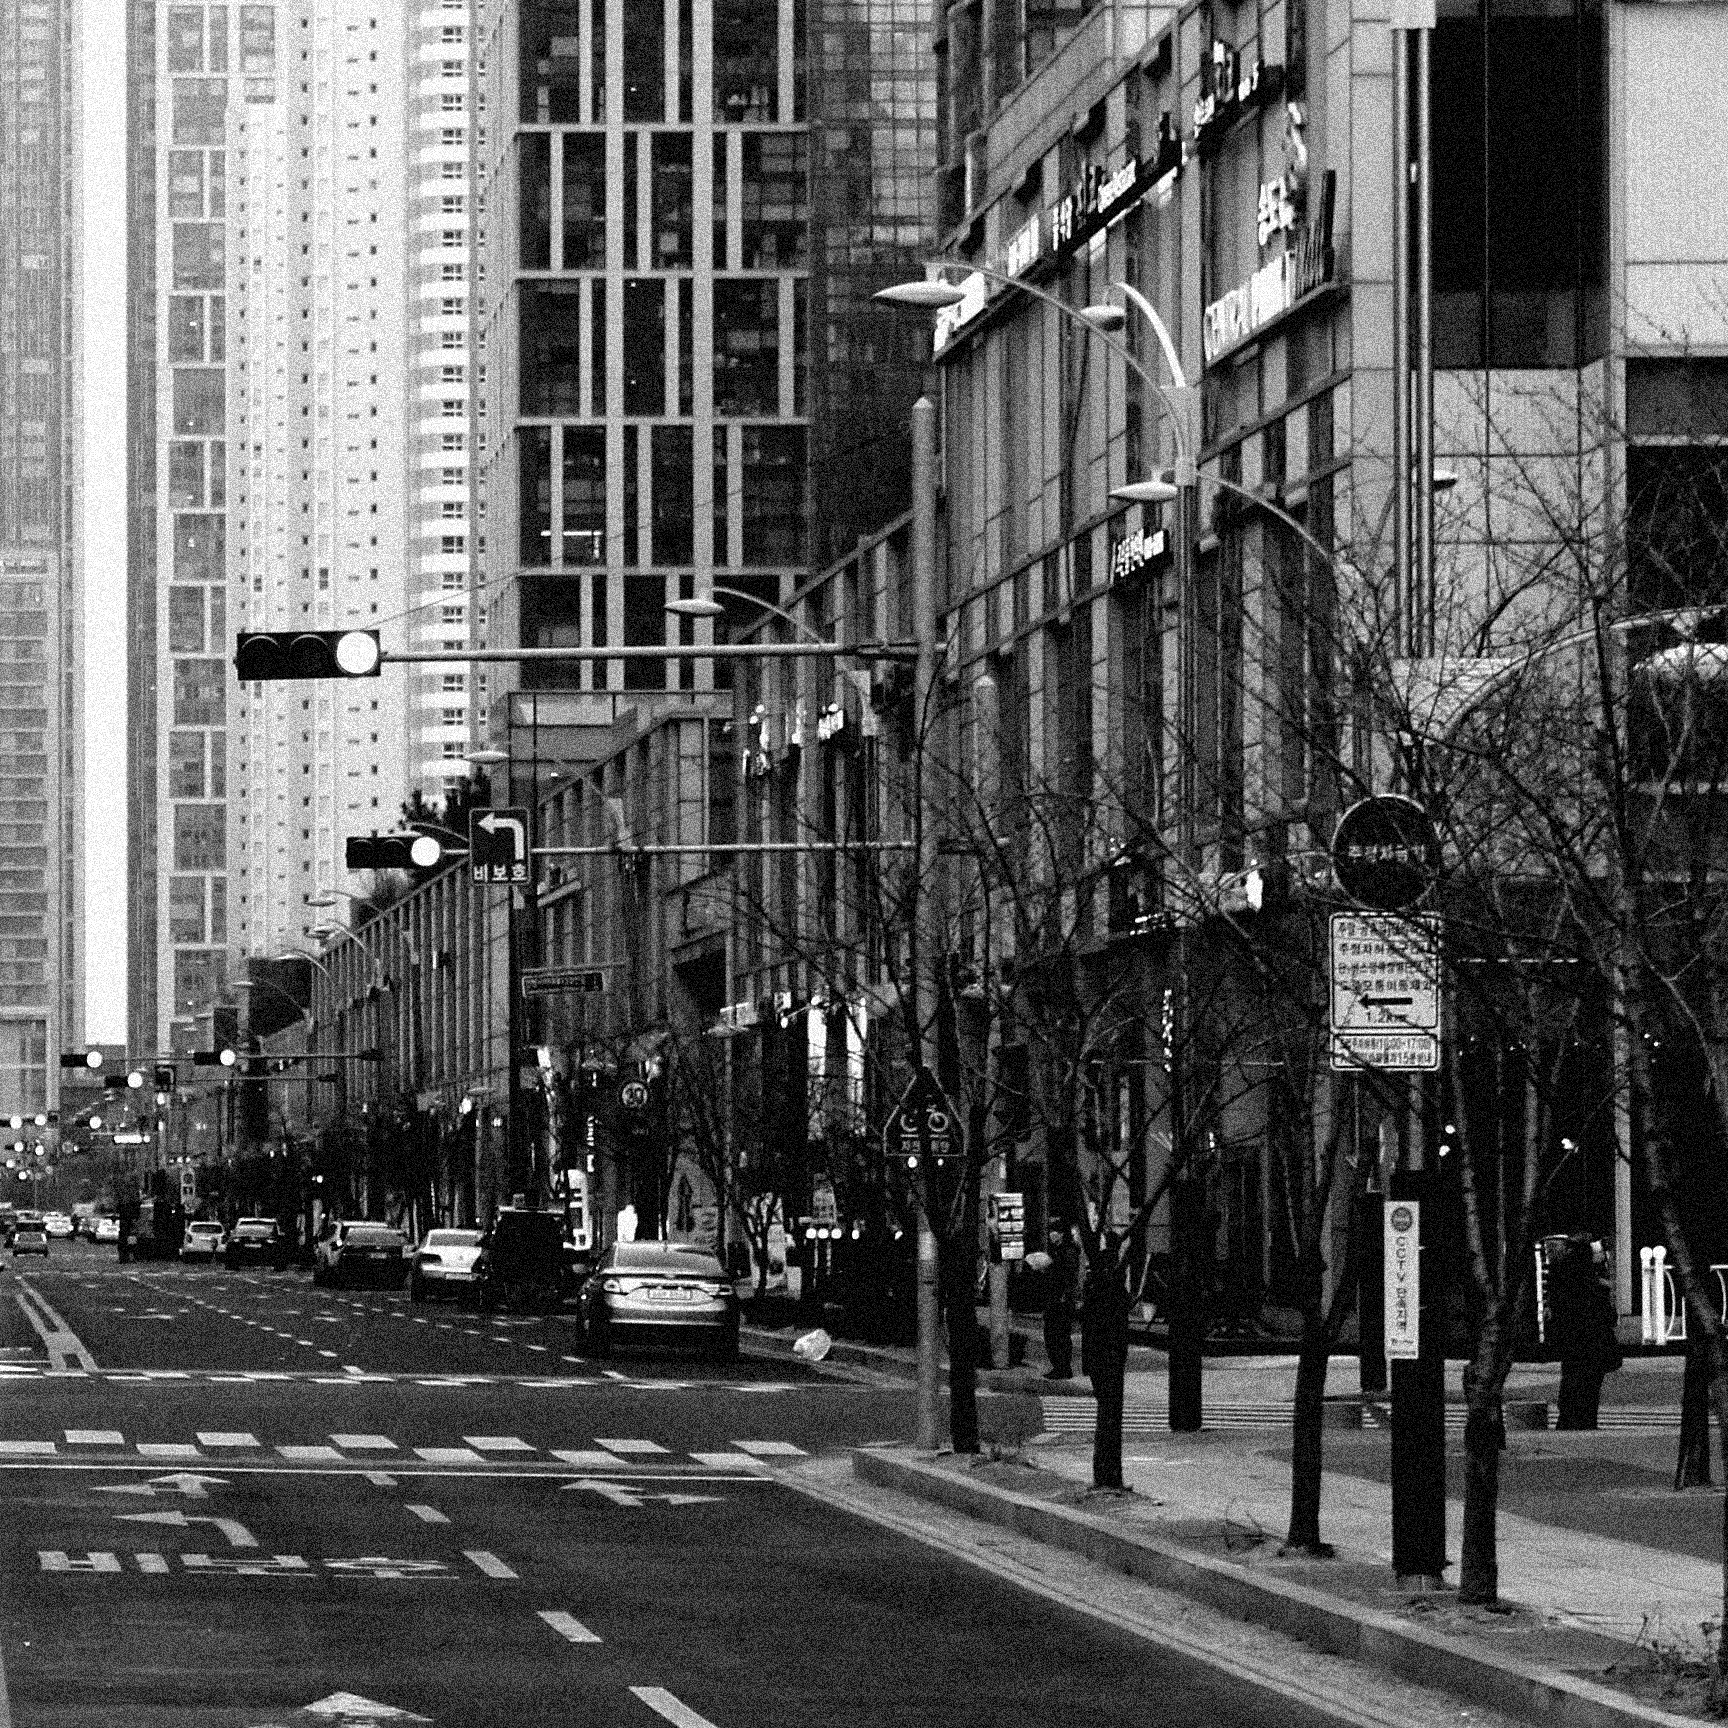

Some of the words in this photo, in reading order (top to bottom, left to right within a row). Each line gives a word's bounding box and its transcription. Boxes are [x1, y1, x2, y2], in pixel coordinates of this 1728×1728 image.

[473, 863, 527, 883] 비보호
[1395, 1236, 1407, 1282] CCTV
[37, 1550, 460, 1580] 비보호
